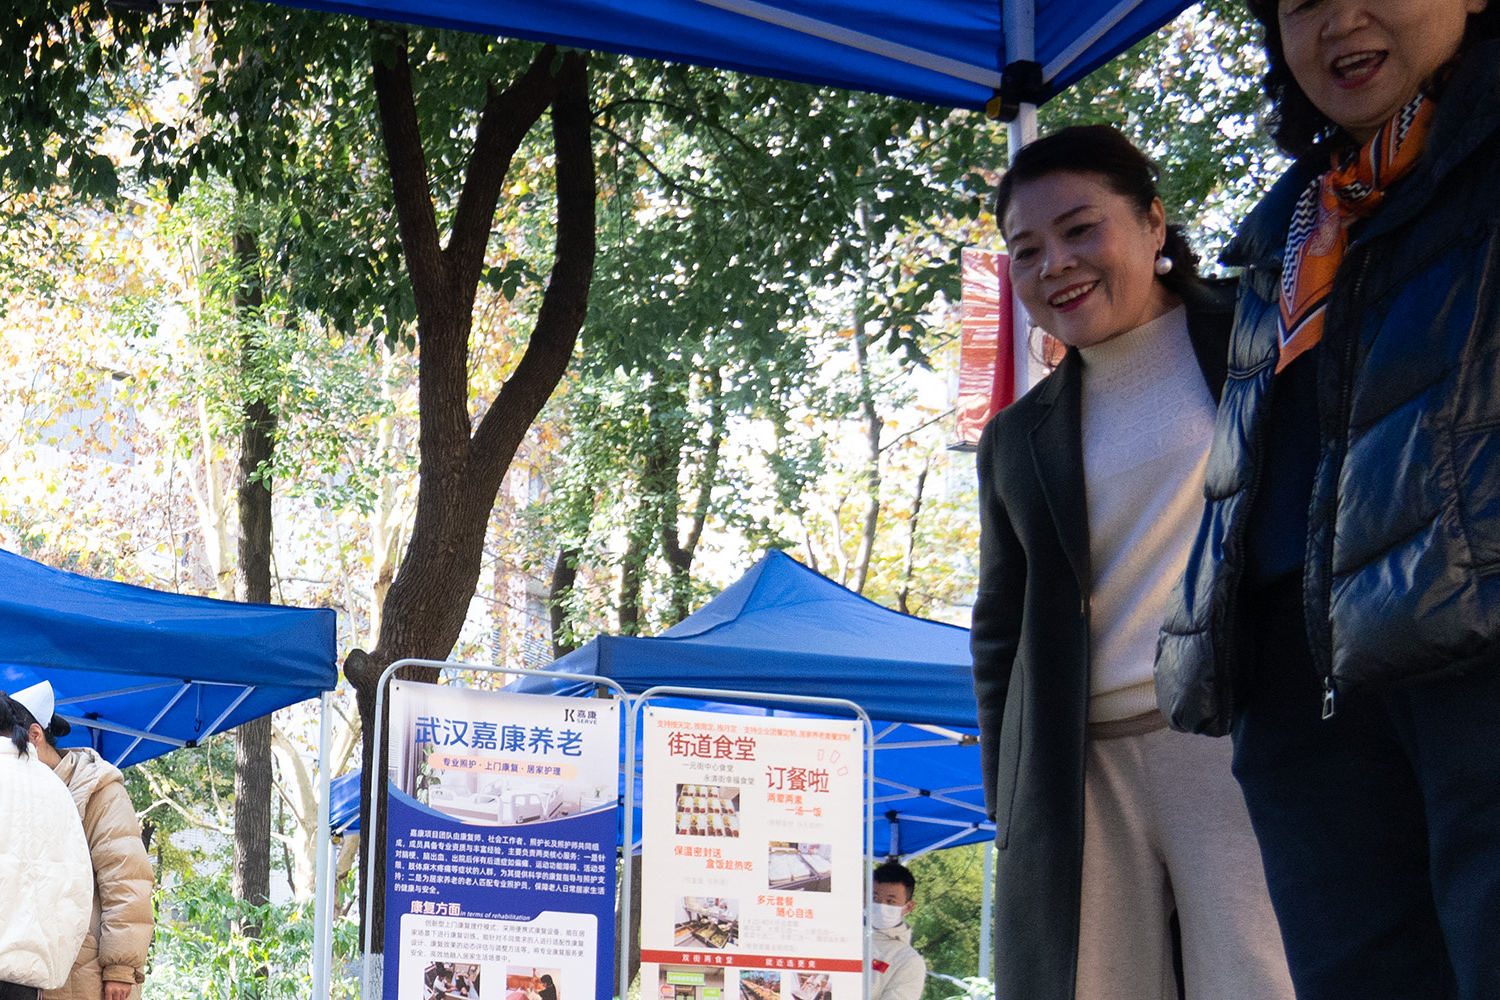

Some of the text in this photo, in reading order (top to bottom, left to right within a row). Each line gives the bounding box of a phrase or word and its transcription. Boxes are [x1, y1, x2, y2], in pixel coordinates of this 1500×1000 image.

[577, 709, 597, 720] 嘉康
[415, 716, 583, 758] 武汉嘉康养老
[667, 731, 756, 762] 街道食堂
[681, 761, 734, 773] 一元街中心食堂
[703, 774, 755, 786] 永清街幸福食堂
[765, 764, 829, 793] 订餐啦
[767, 792, 803, 805] 两荤两素
[785, 806, 822, 818] 一汤一饭
[410, 828, 599, 852] 嘉康项目团队由康复师、社会工作者、照护长及照护师共同组
[674, 845, 722, 859] 保温密封送
[706, 858, 754, 871] 盒饭趁热吃
[394, 883, 440, 895] 的健康与安全。
[757, 894, 794, 907] 多元套餐
[410, 900, 461, 916] 康复方面
[776, 906, 814, 920] 随心自选
[467, 910, 483, 919] terms
[484, 910, 492, 919] of
[492, 911, 531, 921] rehabilitation
